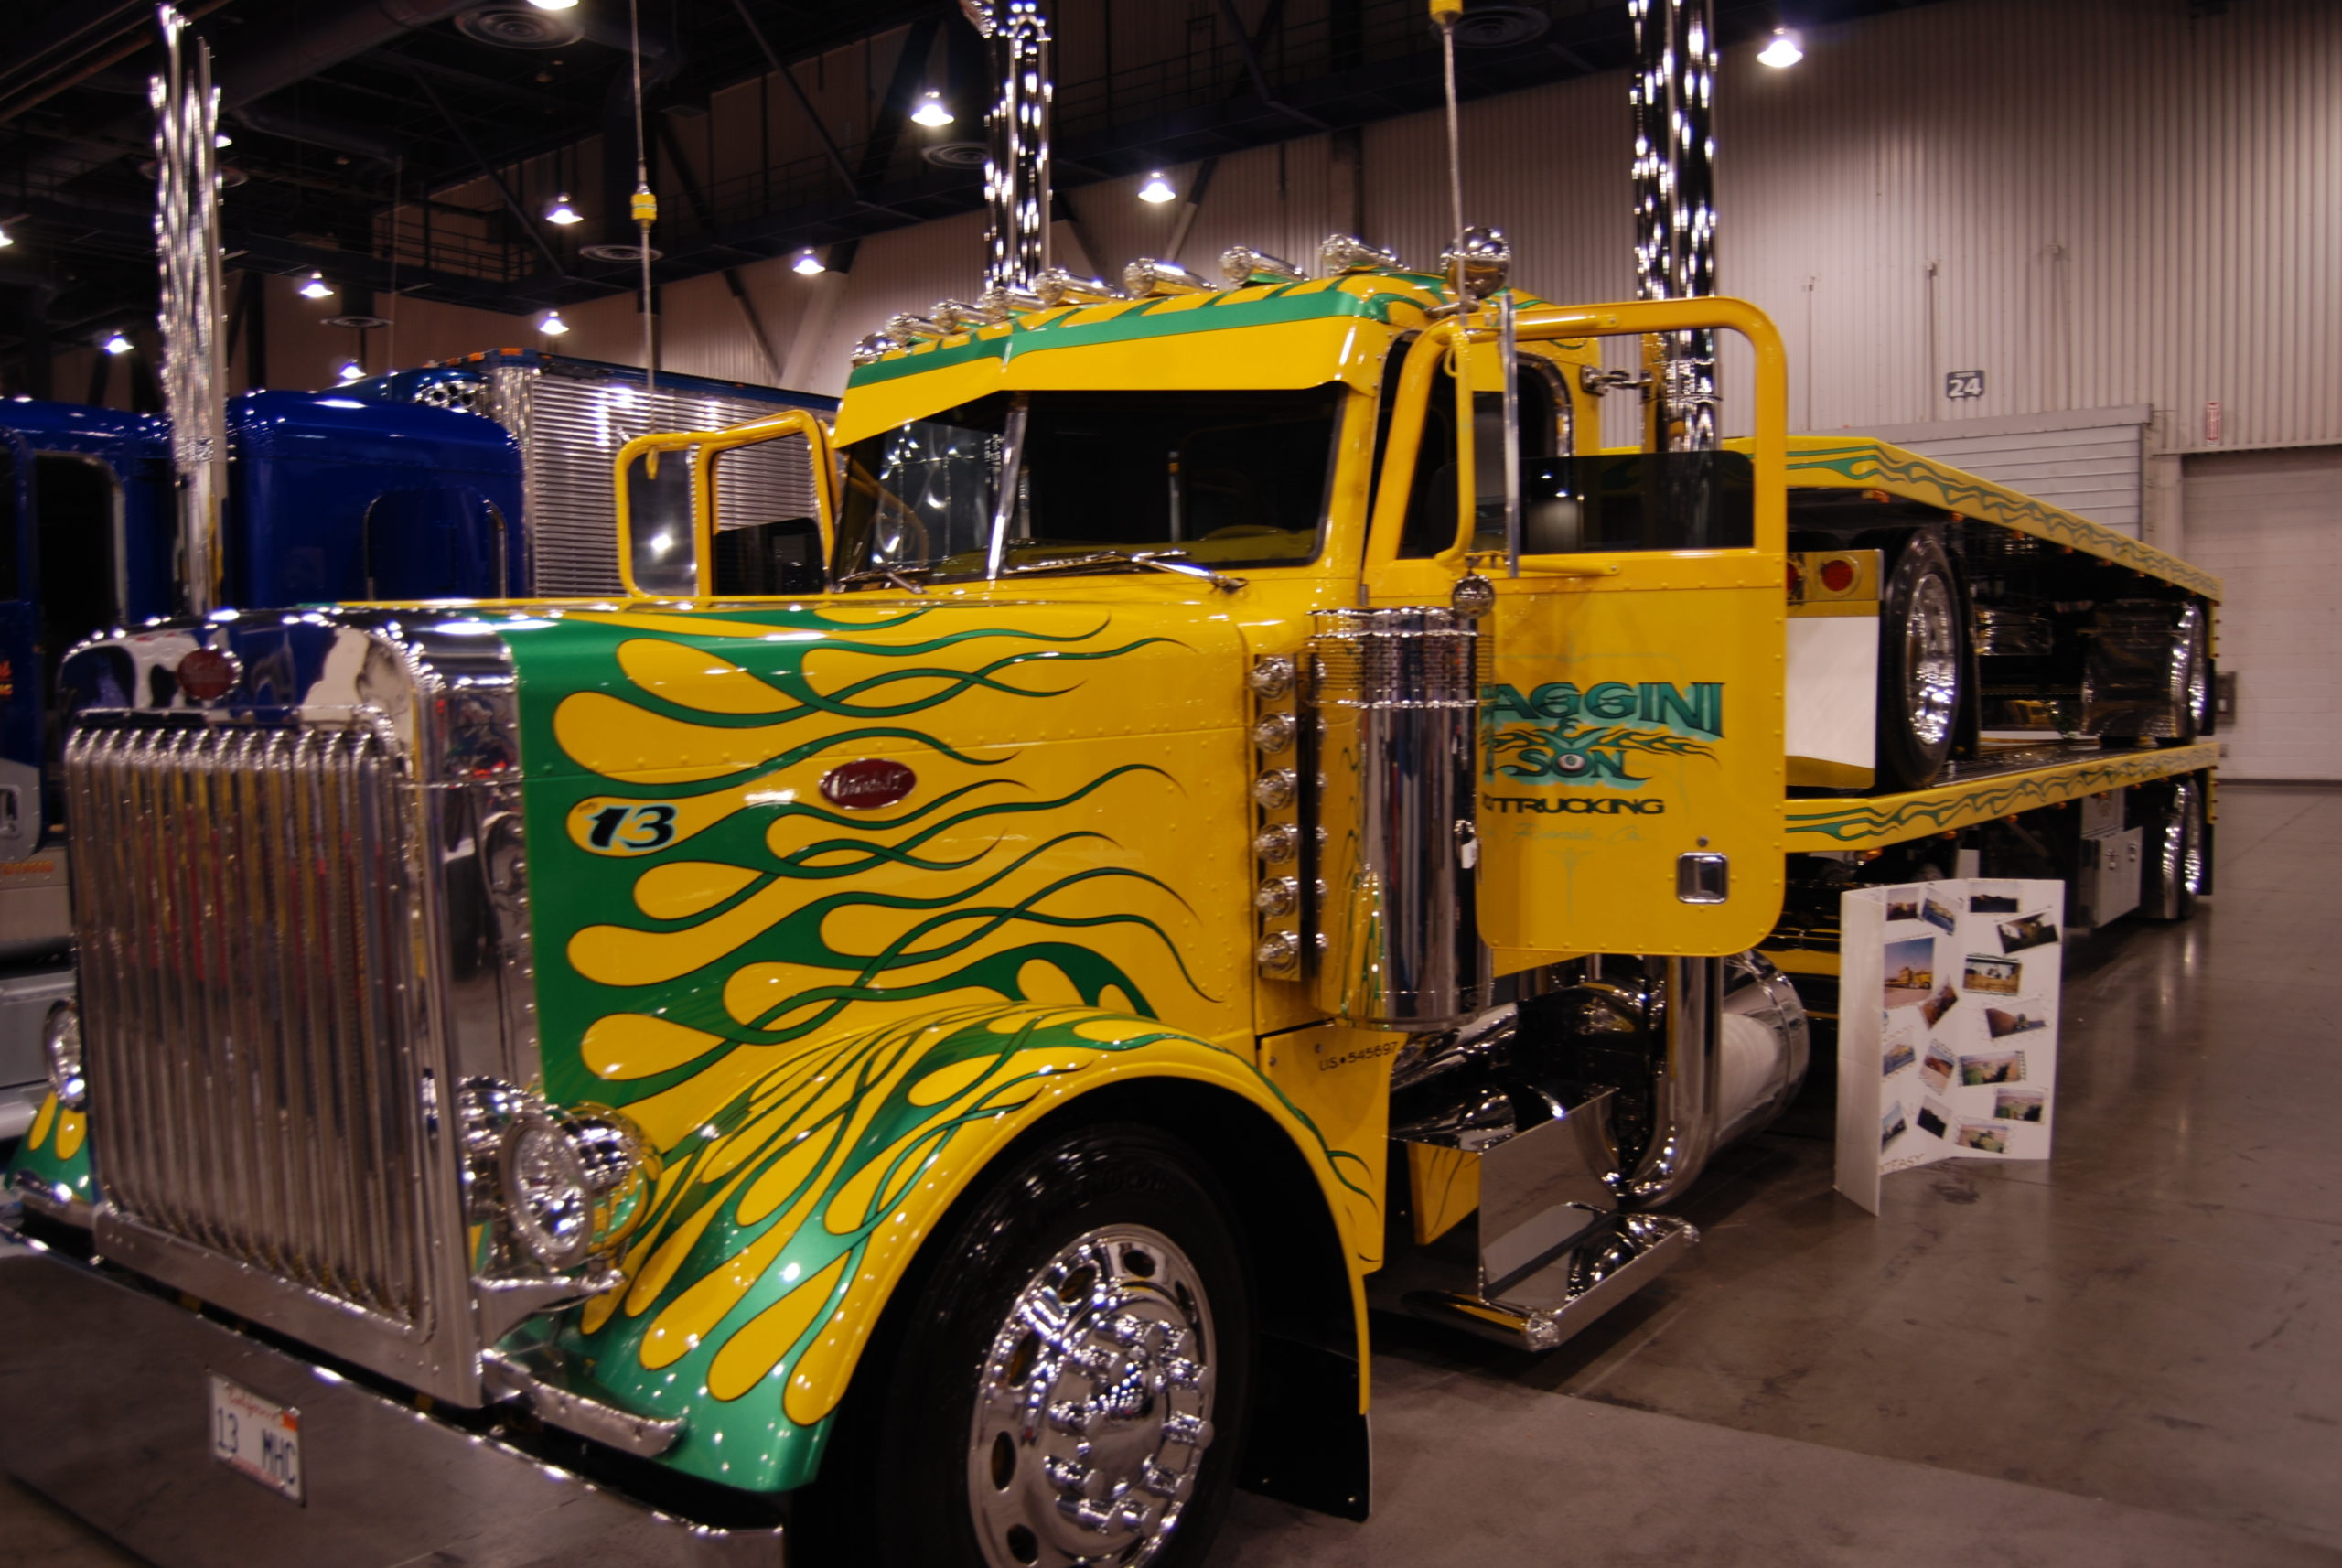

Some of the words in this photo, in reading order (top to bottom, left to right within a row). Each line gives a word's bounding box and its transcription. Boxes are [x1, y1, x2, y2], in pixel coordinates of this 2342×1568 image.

[1949, 378, 1982, 397] 24
[1493, 682, 1726, 739] AGGINI
[1495, 748, 1653, 781] SON
[1492, 797, 1665, 814] TRUCKING
[584, 802, 678, 852] 13
[217, 1407, 239, 1454] 13
